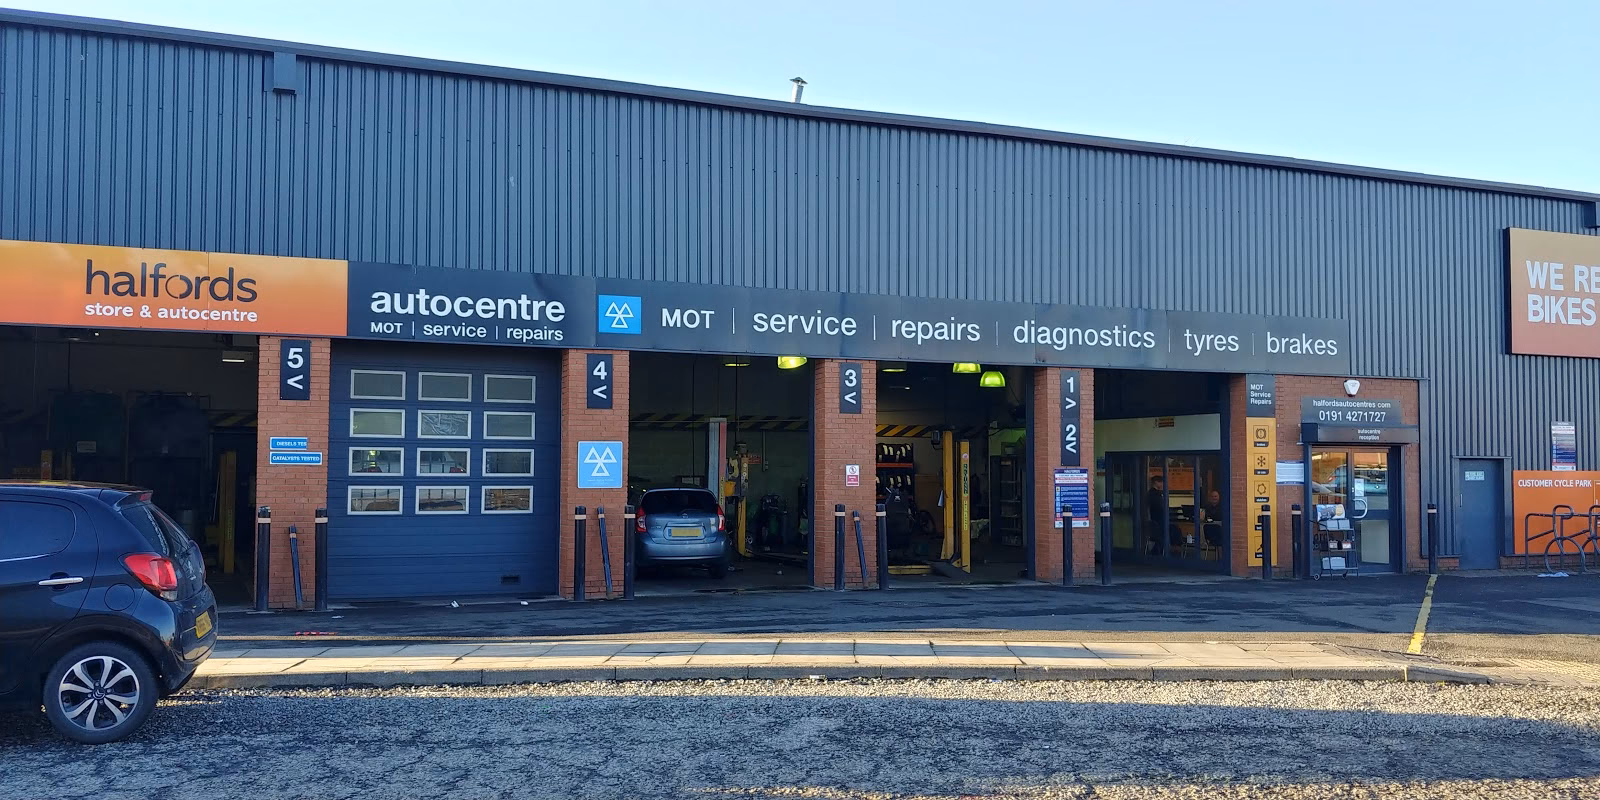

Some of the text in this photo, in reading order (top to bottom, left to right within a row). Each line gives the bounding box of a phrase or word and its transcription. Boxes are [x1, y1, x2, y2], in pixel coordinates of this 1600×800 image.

[86, 259, 258, 302] halfords
[1526, 260, 1564, 291] WE
[85, 303, 258, 322] store & autocentre
[370, 288, 566, 322] autocentre
[1527, 293, 1597, 326] BIKES
[370, 322, 564, 343] MOT service repairs
[661, 308, 1338, 356] MOT service repairs diagnostics tyres brakes
[287, 347, 304, 369] 5
[593, 360, 608, 380] 4
[844, 368, 857, 387] 3
[1066, 376, 1074, 393] 1
[1250, 383, 1264, 391] MOT
[1250, 390, 1272, 398] Service
[1250, 398, 1272, 406] Repairs
[1319, 410, 1387, 423] 0191 4271727
[1065, 424, 1077, 442] 2
[1518, 479, 1592, 488] CUSTOMER CYCLE PARK
